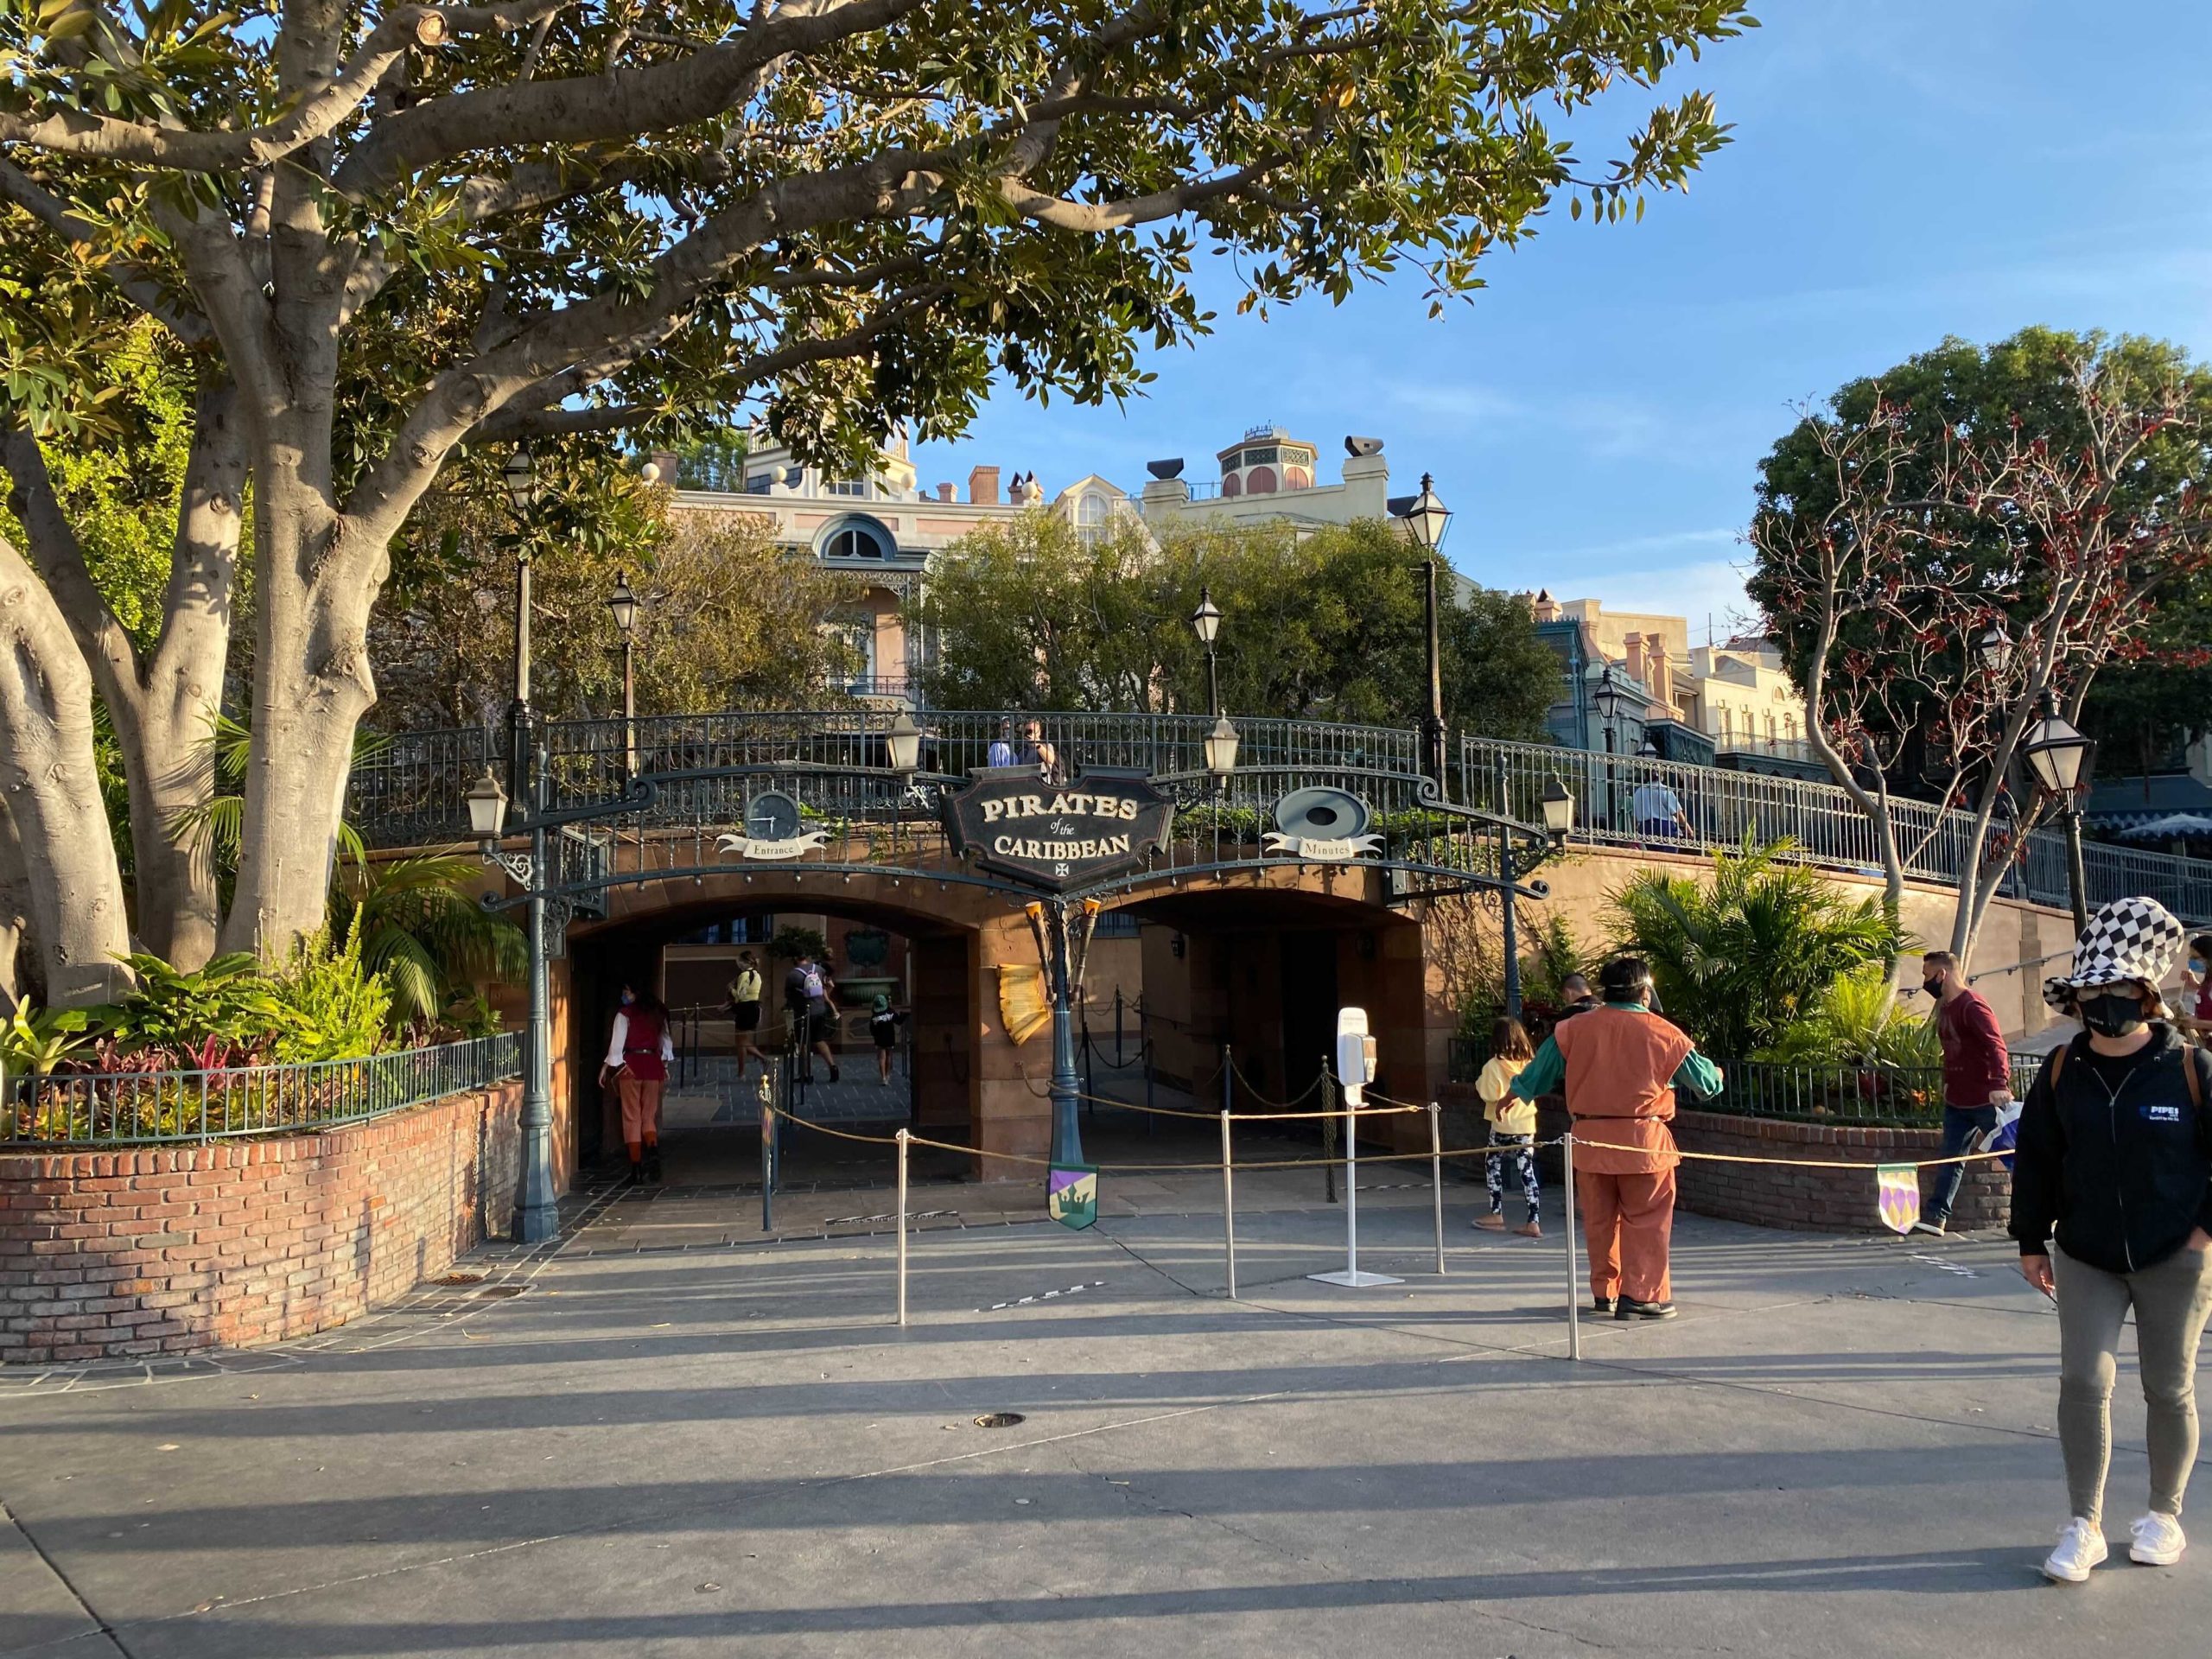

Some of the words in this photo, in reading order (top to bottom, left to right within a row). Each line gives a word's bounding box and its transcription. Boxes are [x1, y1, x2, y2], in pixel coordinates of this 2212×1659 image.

[980, 793, 1138, 822] PIRATES
[1050, 817, 1063, 835] of
[1059, 823, 1075, 836] the
[753, 844, 794, 855] Entrance
[994, 834, 1131, 861] CARIBBEAN
[1305, 842, 1351, 855] Minutes
